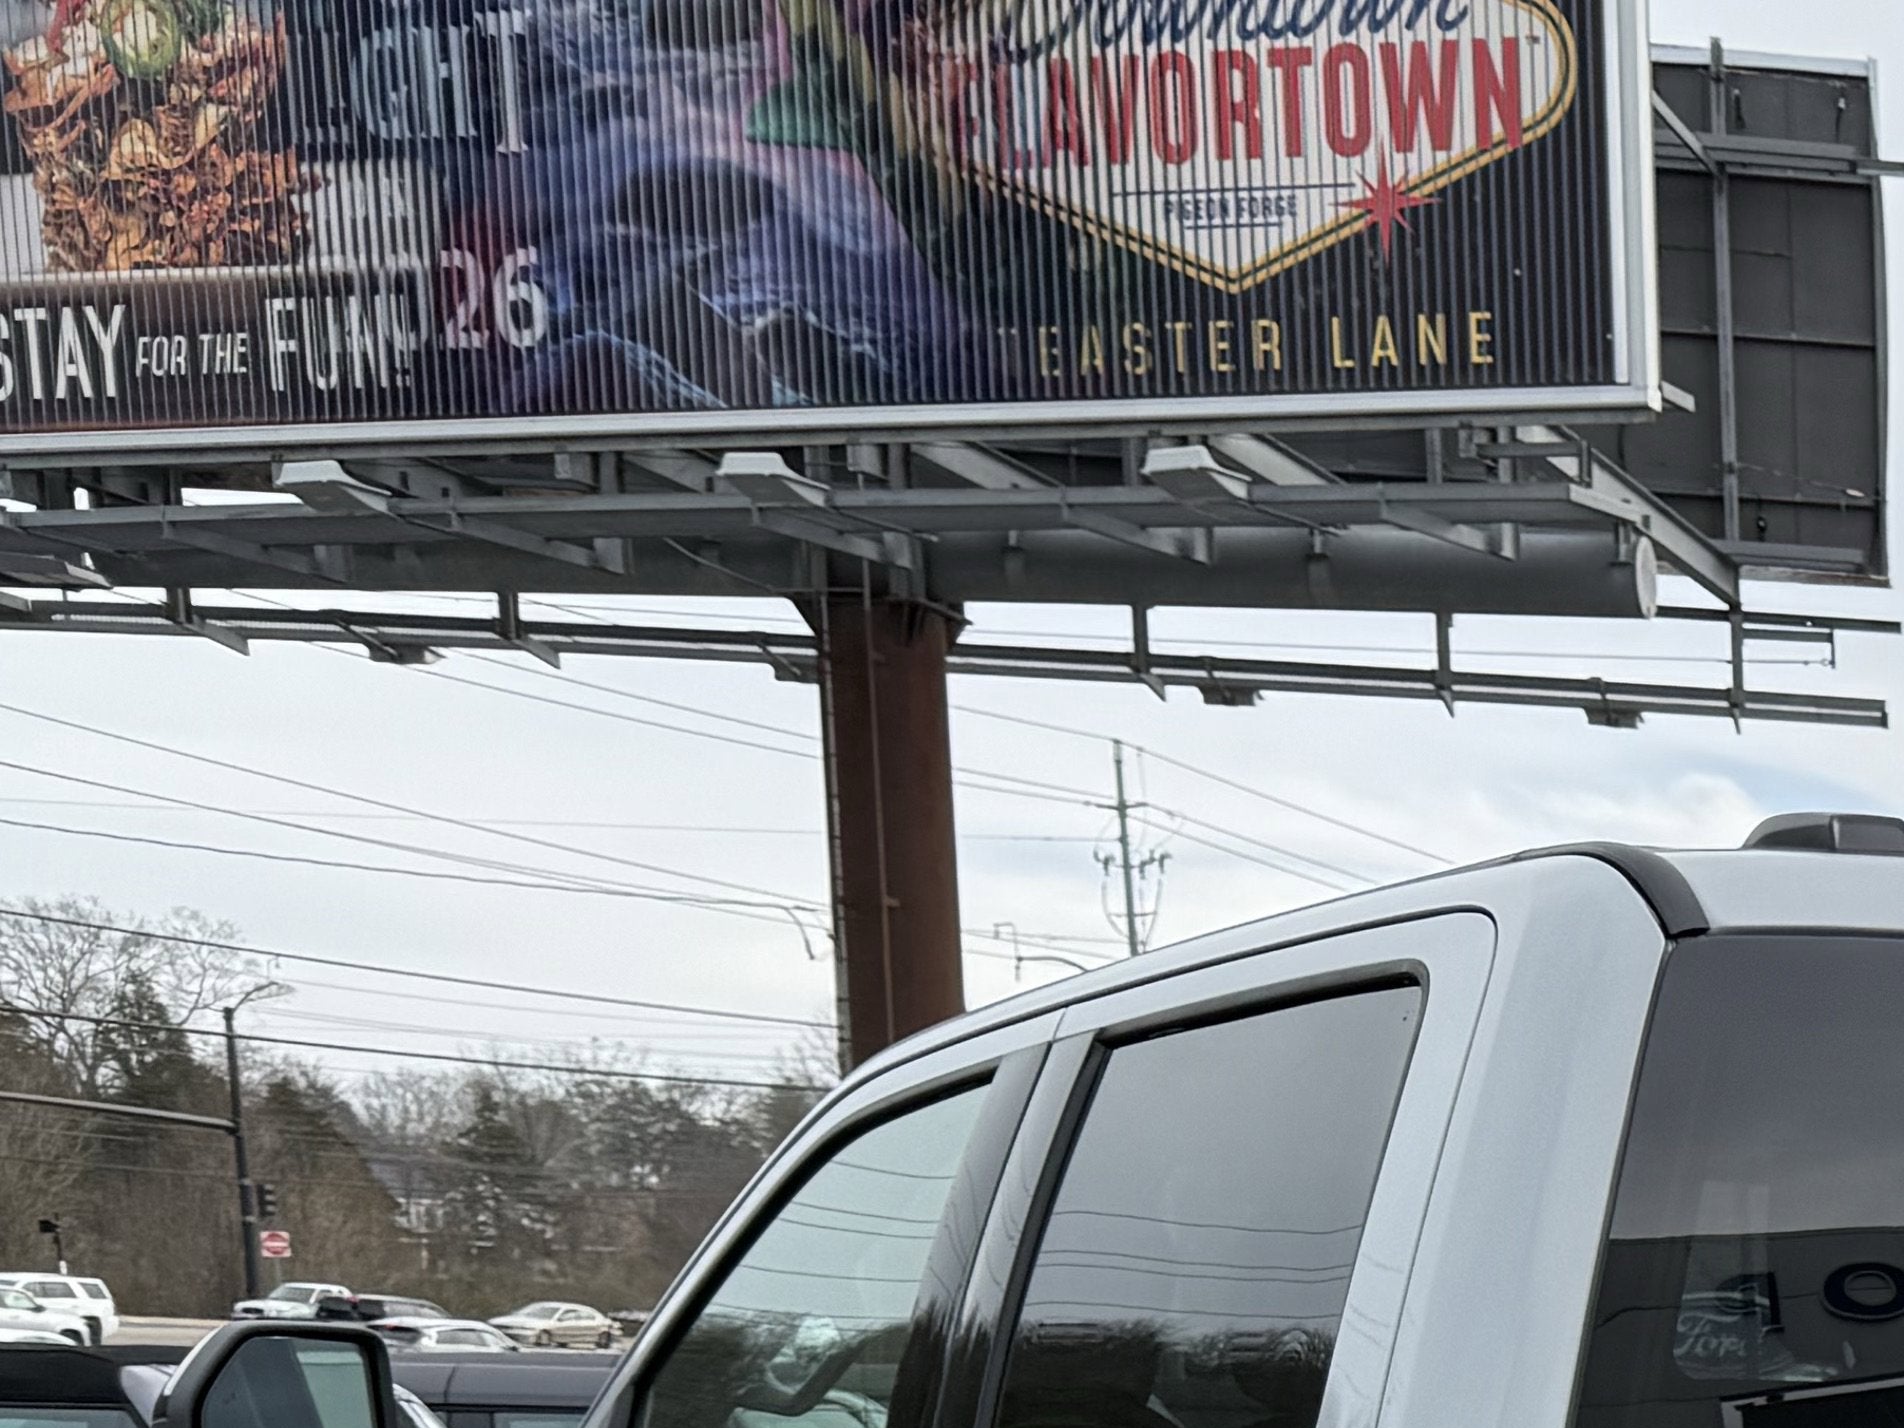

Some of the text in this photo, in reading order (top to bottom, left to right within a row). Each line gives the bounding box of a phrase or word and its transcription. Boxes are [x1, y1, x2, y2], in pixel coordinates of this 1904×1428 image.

[1162, 196, 1231, 221] PGEON
[136, 334, 188, 377] FOR
[199, 332, 248, 375] THE
[997, 310, 1496, 378] EASTER LANE
